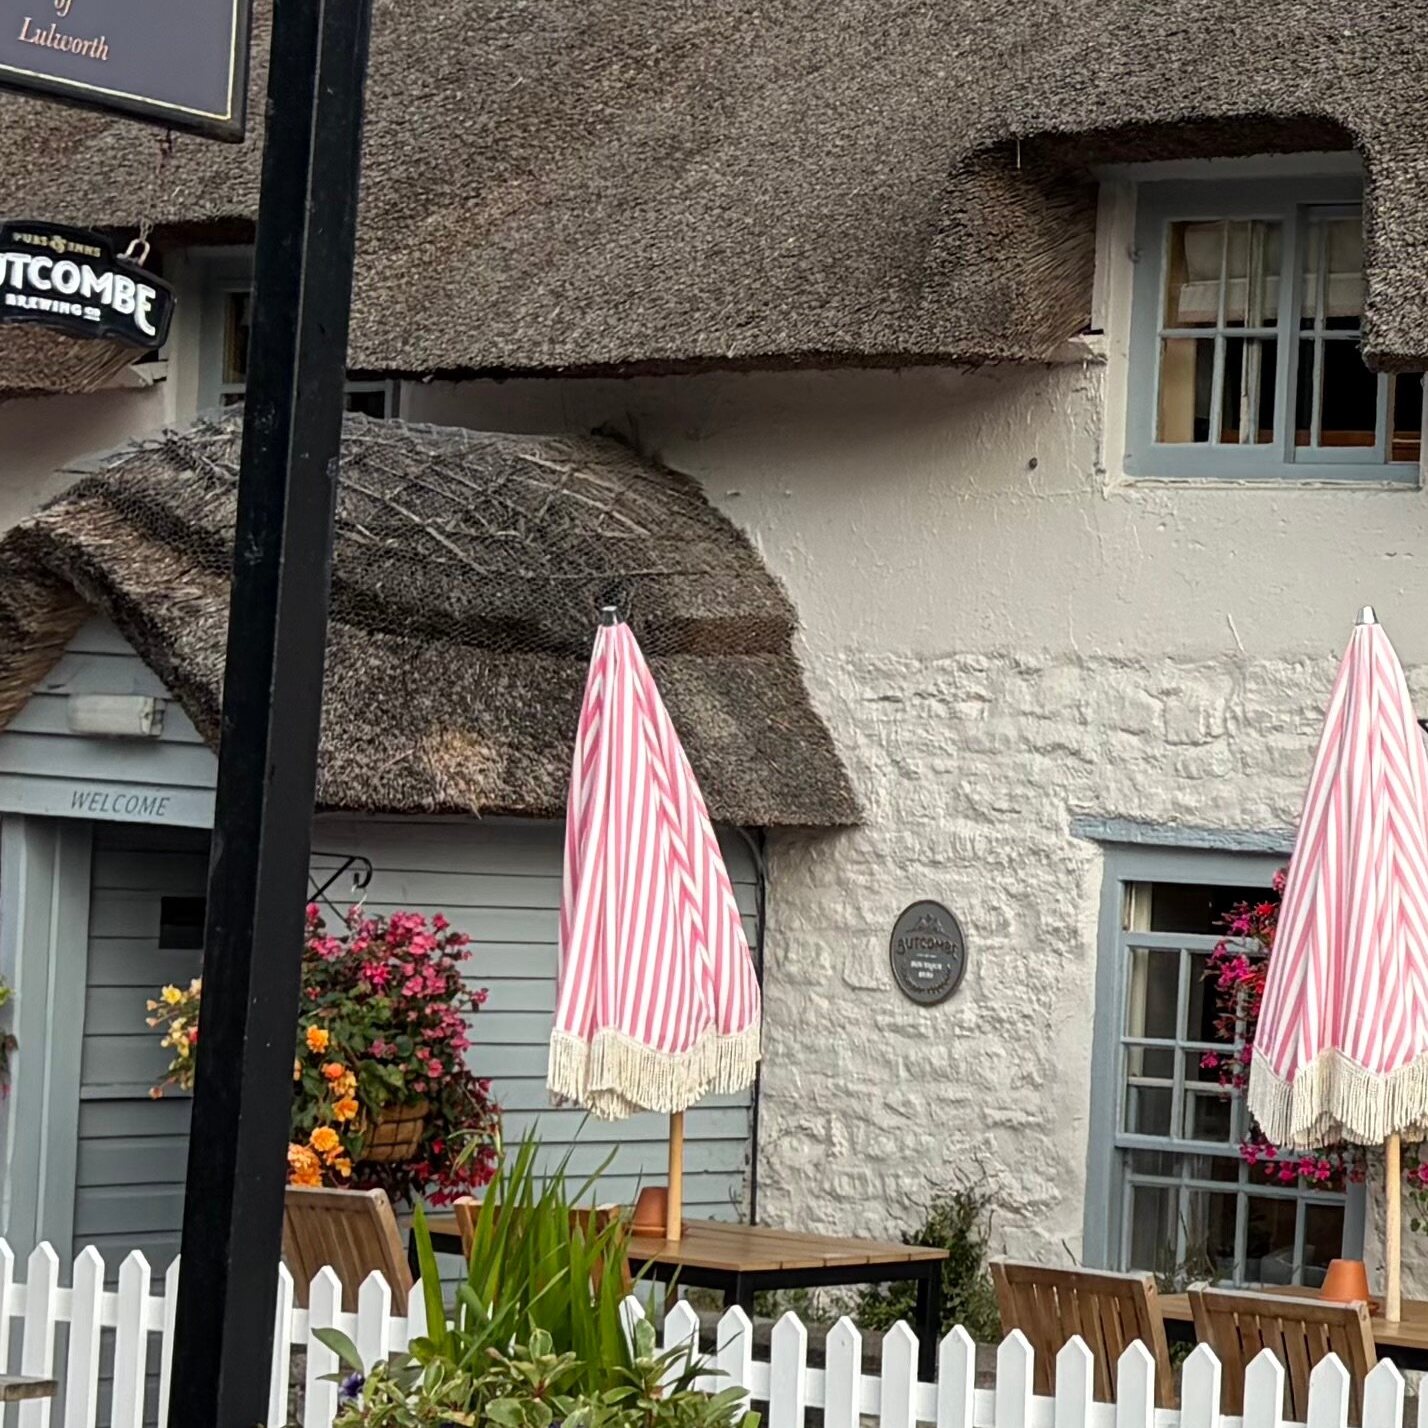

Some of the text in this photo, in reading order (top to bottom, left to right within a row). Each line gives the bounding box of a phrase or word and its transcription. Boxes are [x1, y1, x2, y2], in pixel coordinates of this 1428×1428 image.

[18, 17, 109, 61] Lulworth
[12, 232, 48, 247] PUBS
[68, 242, 101, 258] INNS
[5, 293, 82, 315] BREWING
[71, 790, 170, 816] WELCOME
